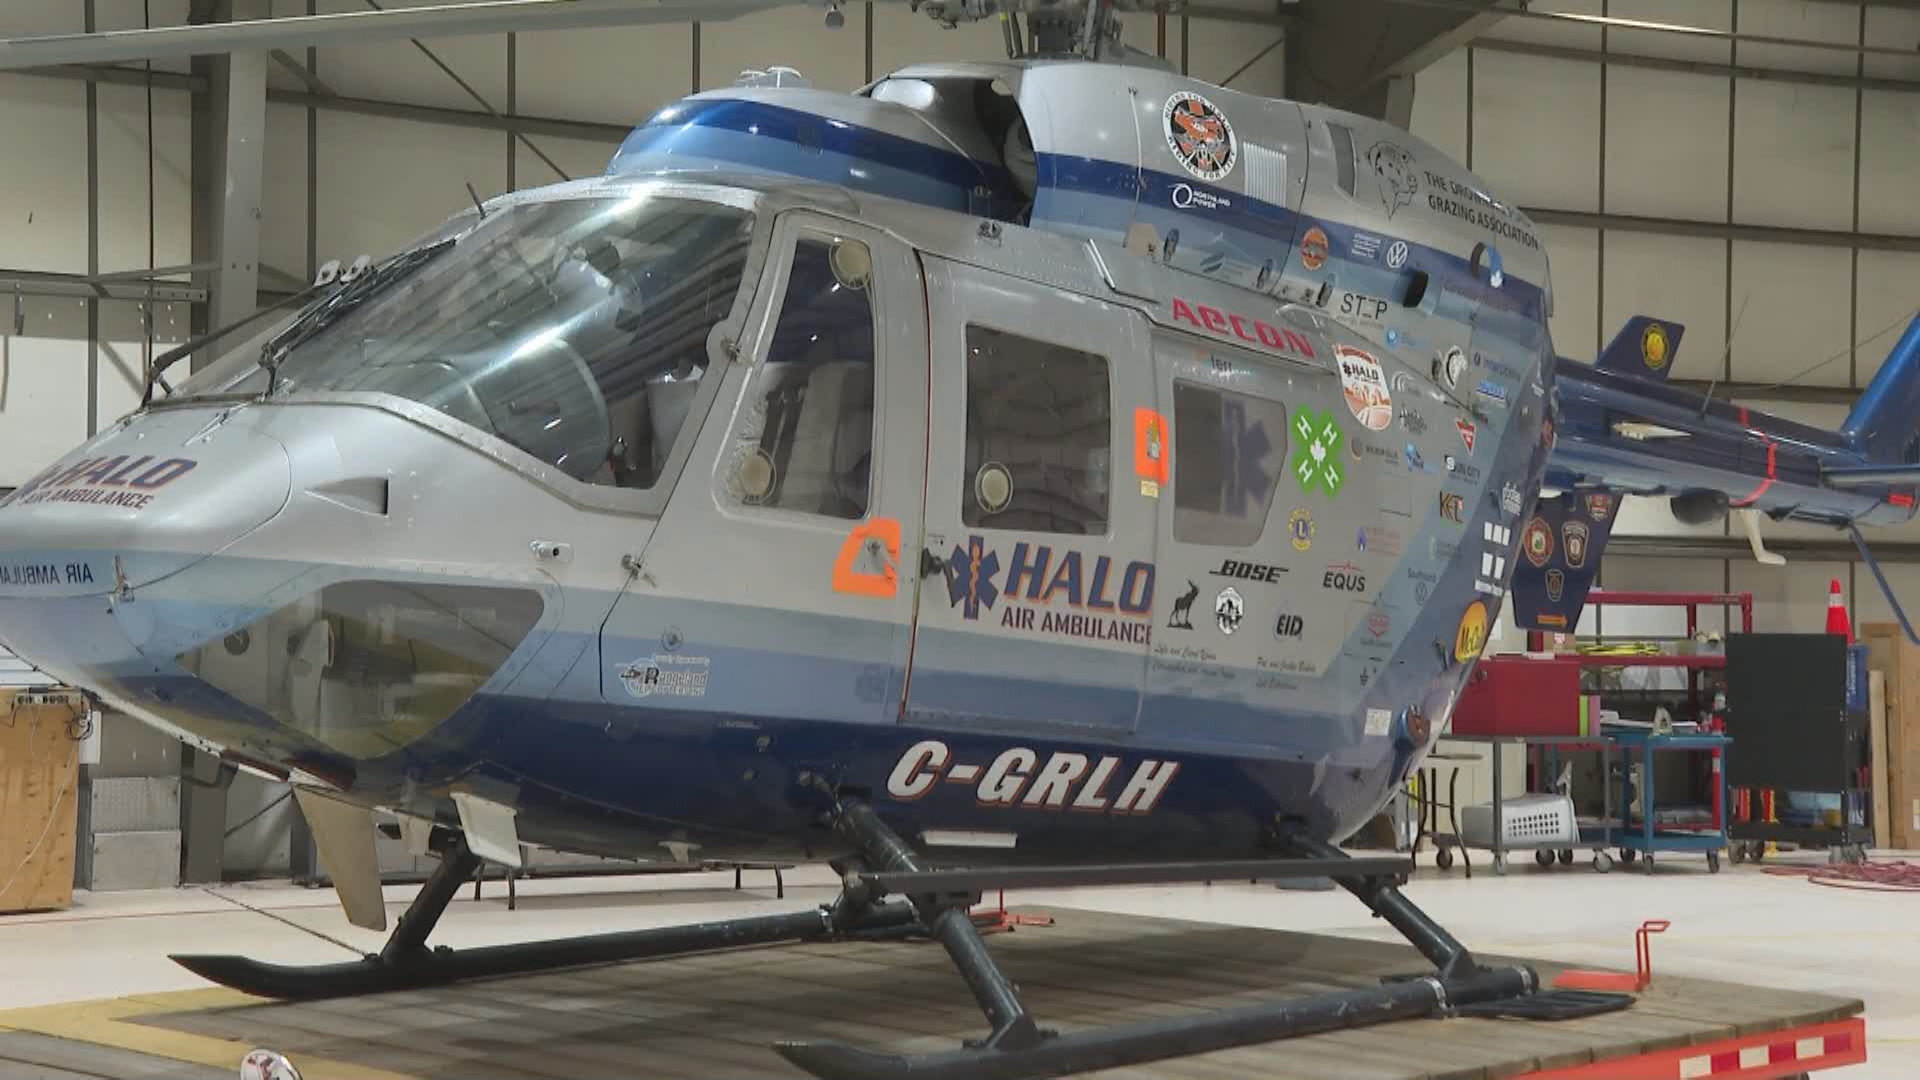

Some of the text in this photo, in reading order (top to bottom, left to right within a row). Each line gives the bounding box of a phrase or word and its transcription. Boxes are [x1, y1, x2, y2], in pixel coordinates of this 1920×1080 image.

[1424, 170, 1448, 192] THE
[1193, 197, 1217, 209] POWER
[1428, 194, 1476, 224] GRAZING
[1478, 211, 1539, 250] ASSOCIATION
[1351, 363, 1380, 381] HALO
[40, 455, 198, 492] HALO
[50, 489, 155, 511] AMBULANCE
[1004, 542, 1156, 616] HALO
[1210, 559, 1288, 584] BOSE
[1322, 571, 1366, 592] EQUS
[1001, 606, 1035, 630] AIR
[1275, 613, 1304, 637] EID
[886, 740, 1178, 815] C-GRLH
